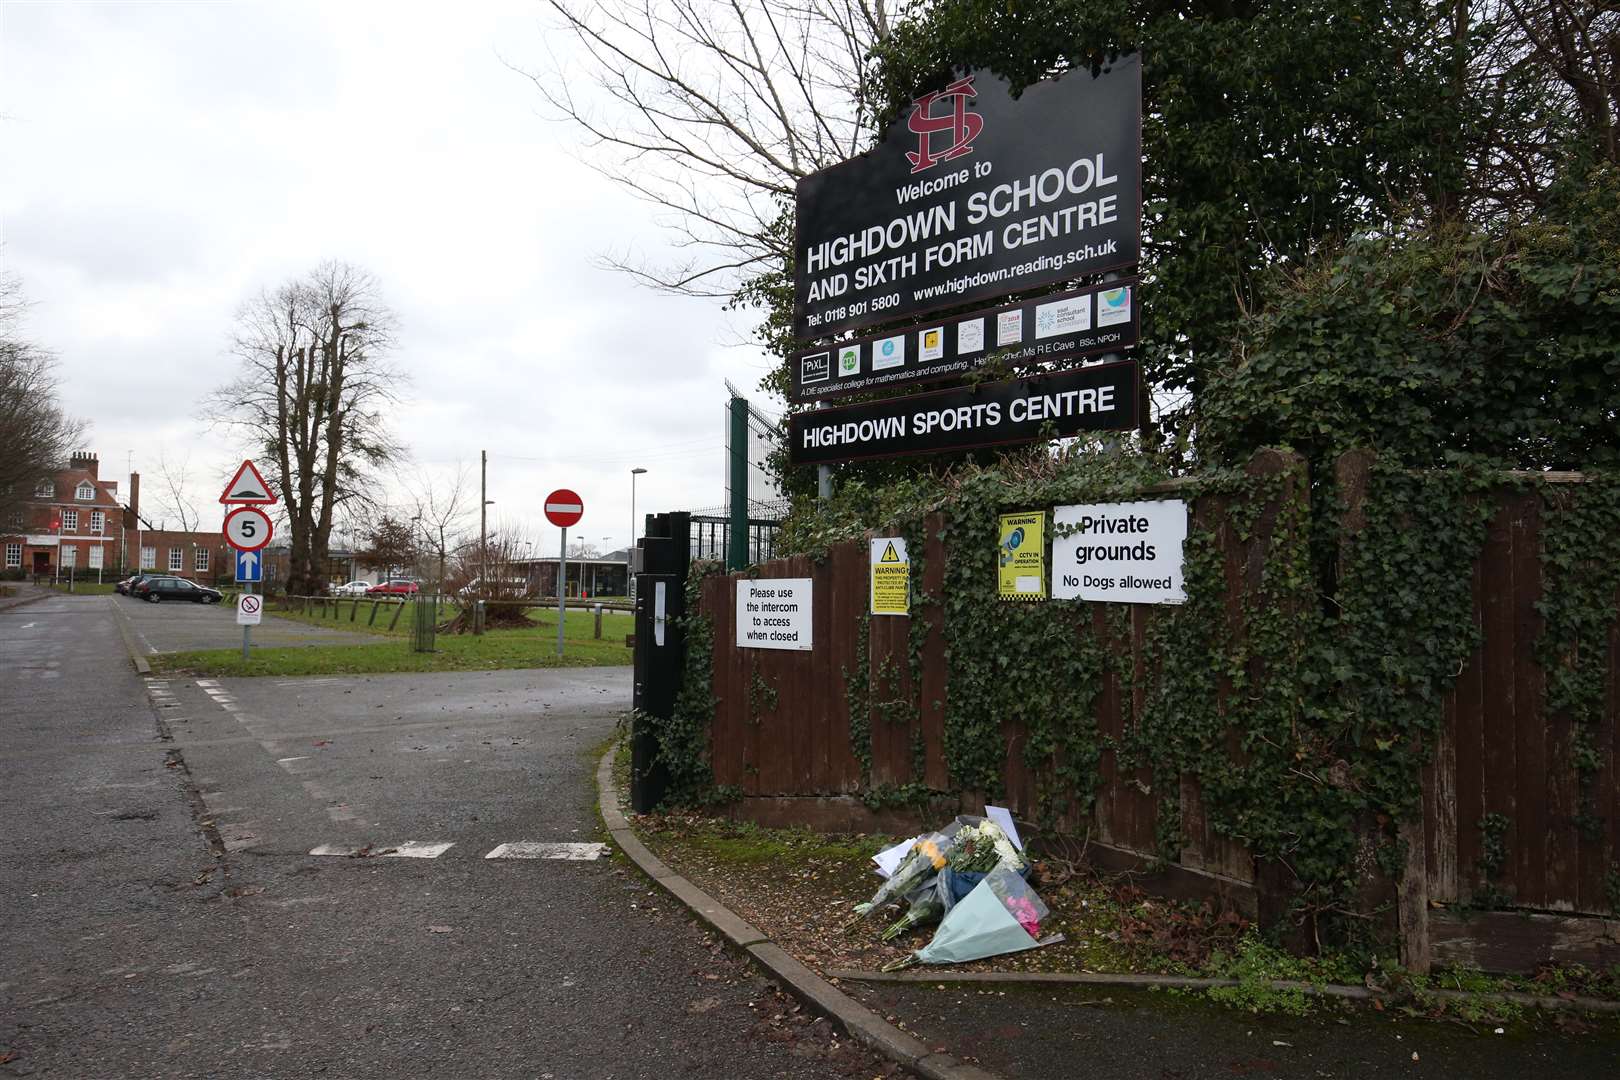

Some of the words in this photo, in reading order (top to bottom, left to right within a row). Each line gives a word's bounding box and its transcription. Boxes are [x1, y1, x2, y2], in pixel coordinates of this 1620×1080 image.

[896, 170, 969, 205] Welcome
[974, 159, 992, 177] to
[807, 201, 956, 274] HIGHDOWN
[967, 152, 1118, 225] SCHOOL
[807, 272, 848, 304] AND
[854, 255, 917, 291] SIXTH
[925, 230, 994, 272] FORM
[1002, 194, 1118, 250] CENTRE
[913, 239, 1117, 302] www.highdown.reading.sch.uk
[807, 311, 822, 327] Tel:
[825, 303, 846, 323] 0118
[849, 300, 868, 318] 901
[871, 292, 900, 312] 5800
[1023, 347, 1035, 358] Ms
[1037, 344, 1044, 354] R
[1045, 343, 1052, 353] E
[1053, 340, 1075, 352] Cave
[1097, 333, 1120, 344] NPQH
[800, 388, 806, 396] A
[817, 382, 843, 394] specialist
[843, 379, 865, 389] college
[865, 376, 874, 386] for
[874, 369, 916, 384] mathematics
[916, 366, 930, 377] and
[930, 360, 969, 375] computing.
[803, 415, 906, 449] HIGHDOWN
[912, 402, 1000, 435] SPORTS
[1009, 385, 1115, 423] CENTRE
[241, 520, 256, 538] 5
[1007, 518, 1037, 526] WARNING
[1081, 515, 1149, 535] Private
[1075, 540, 1156, 565] grounds
[874, 567, 905, 575] WARNING
[750, 588, 775, 598] Please
[777, 588, 793, 598] use
[1063, 575, 1079, 587] No
[1083, 575, 1115, 590] Dogs
[1119, 576, 1172, 590] allowed
[746, 602, 759, 612] the
[761, 602, 798, 612] intercom
[753, 617, 761, 626] to
[763, 618, 790, 627] access
[746, 631, 767, 640] when
[770, 631, 798, 642] closed
